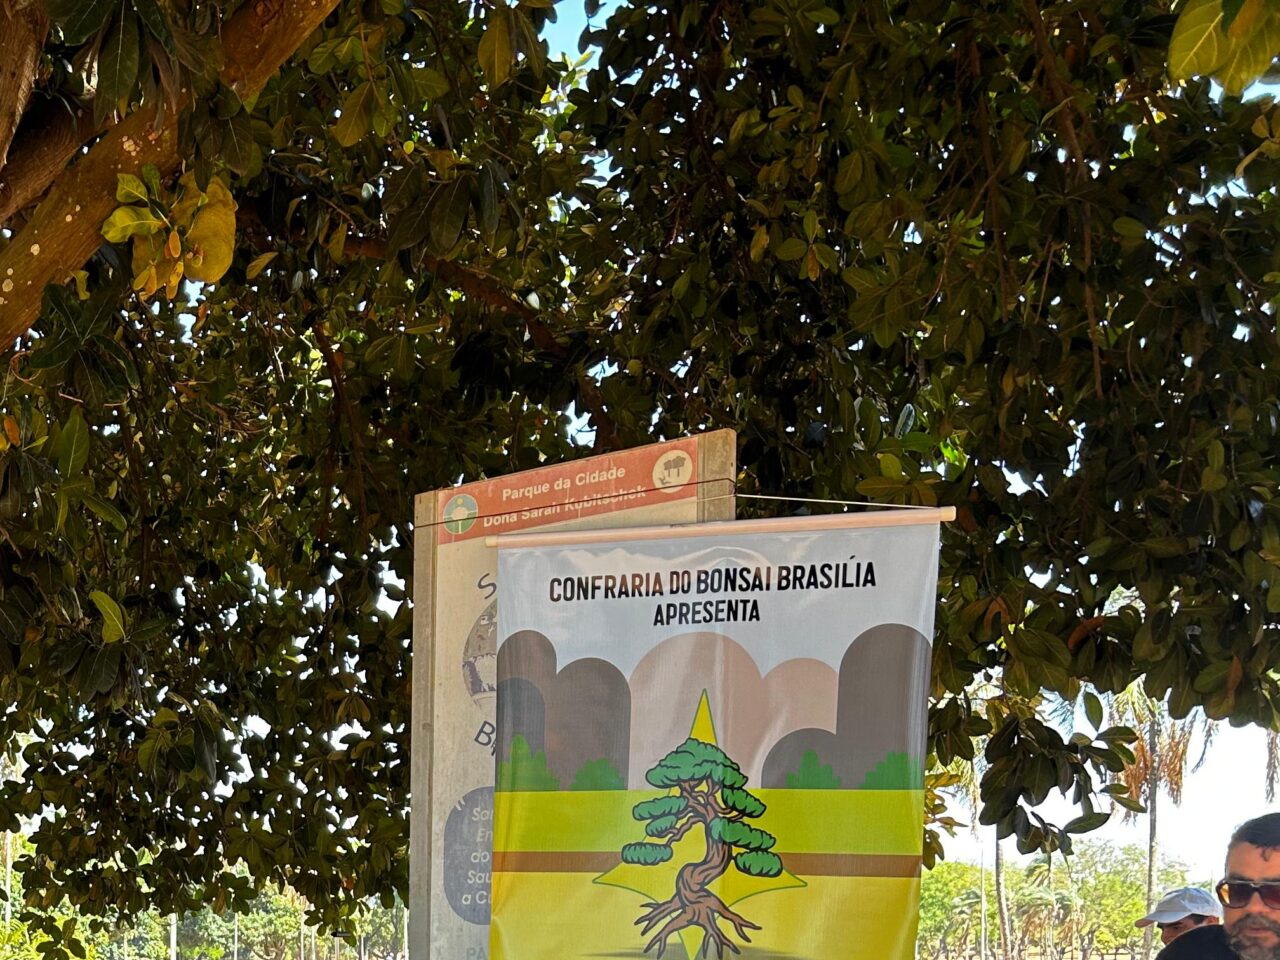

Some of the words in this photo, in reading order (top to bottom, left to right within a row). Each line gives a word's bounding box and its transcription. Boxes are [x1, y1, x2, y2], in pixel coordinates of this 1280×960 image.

[502, 483, 550, 501] Parque
[554, 477, 571, 491] da
[576, 466, 625, 486] Cidade
[483, 510, 518, 528] Dona
[521, 502, 561, 520] Sarah
[565, 485, 646, 512] Kubitschek
[549, 572, 663, 602] CONFRARIA
[669, 570, 692, 595] DO
[696, 566, 771, 594] BONSAI
[777, 555, 877, 591] BRASILÍA
[653, 599, 760, 626] APRESENTA
